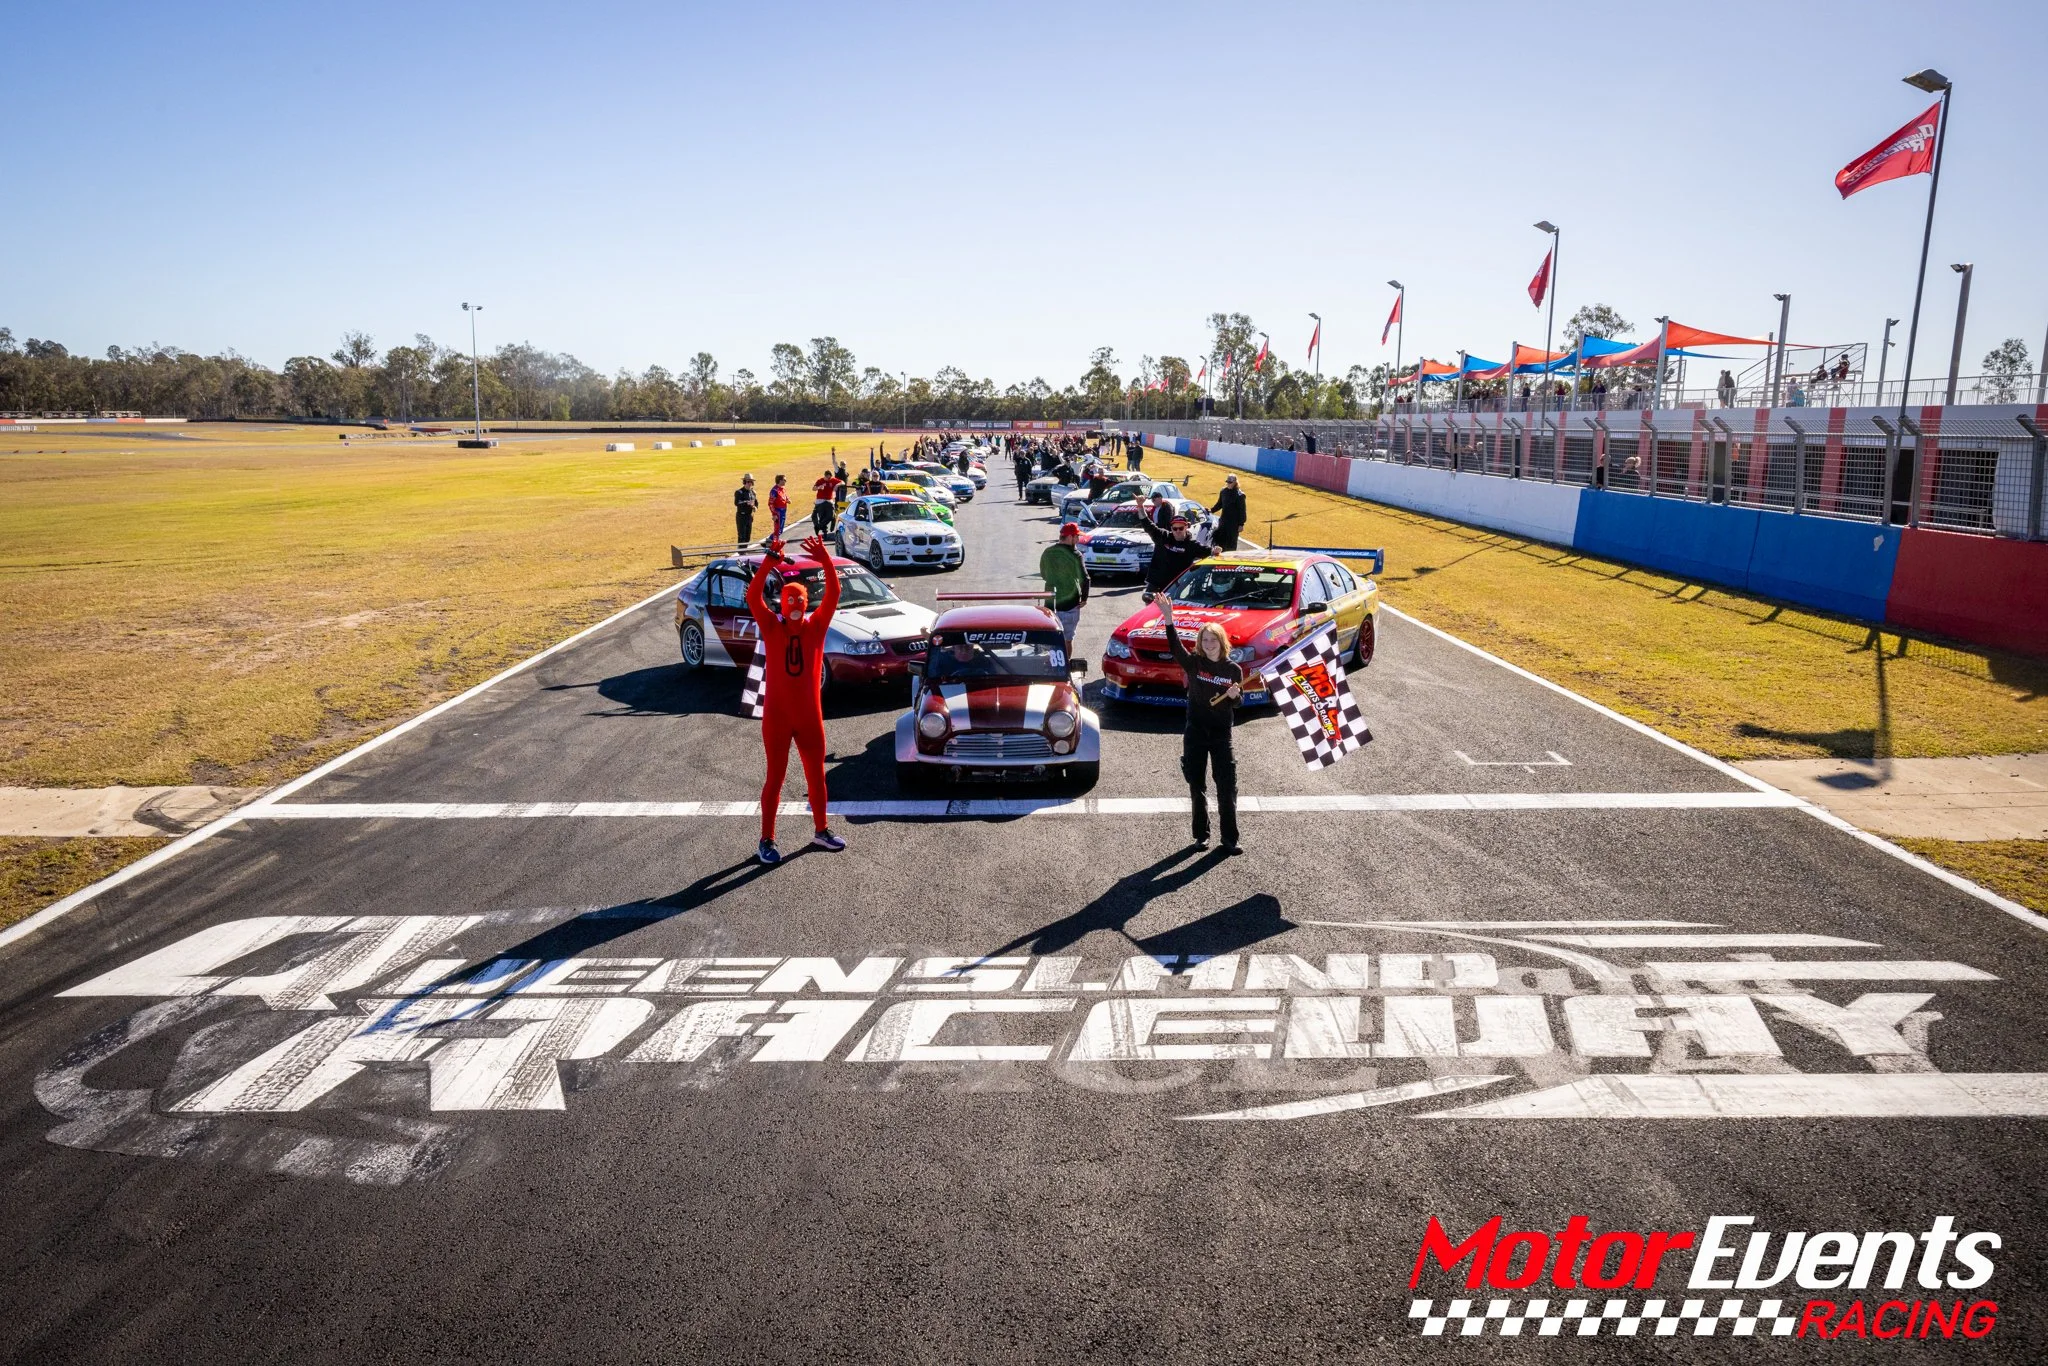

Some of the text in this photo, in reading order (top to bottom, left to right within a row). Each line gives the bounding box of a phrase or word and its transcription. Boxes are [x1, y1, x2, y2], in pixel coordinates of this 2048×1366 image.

[737, 618, 760, 638] 71
[989, 632, 1022, 641] LOGIC
[1049, 649, 1066, 667] 89
[1292, 675, 1320, 703] EVENTS
[54, 915, 1500, 1011] QUEENSLAND
[166, 993, 1937, 1112] RACEWAY
